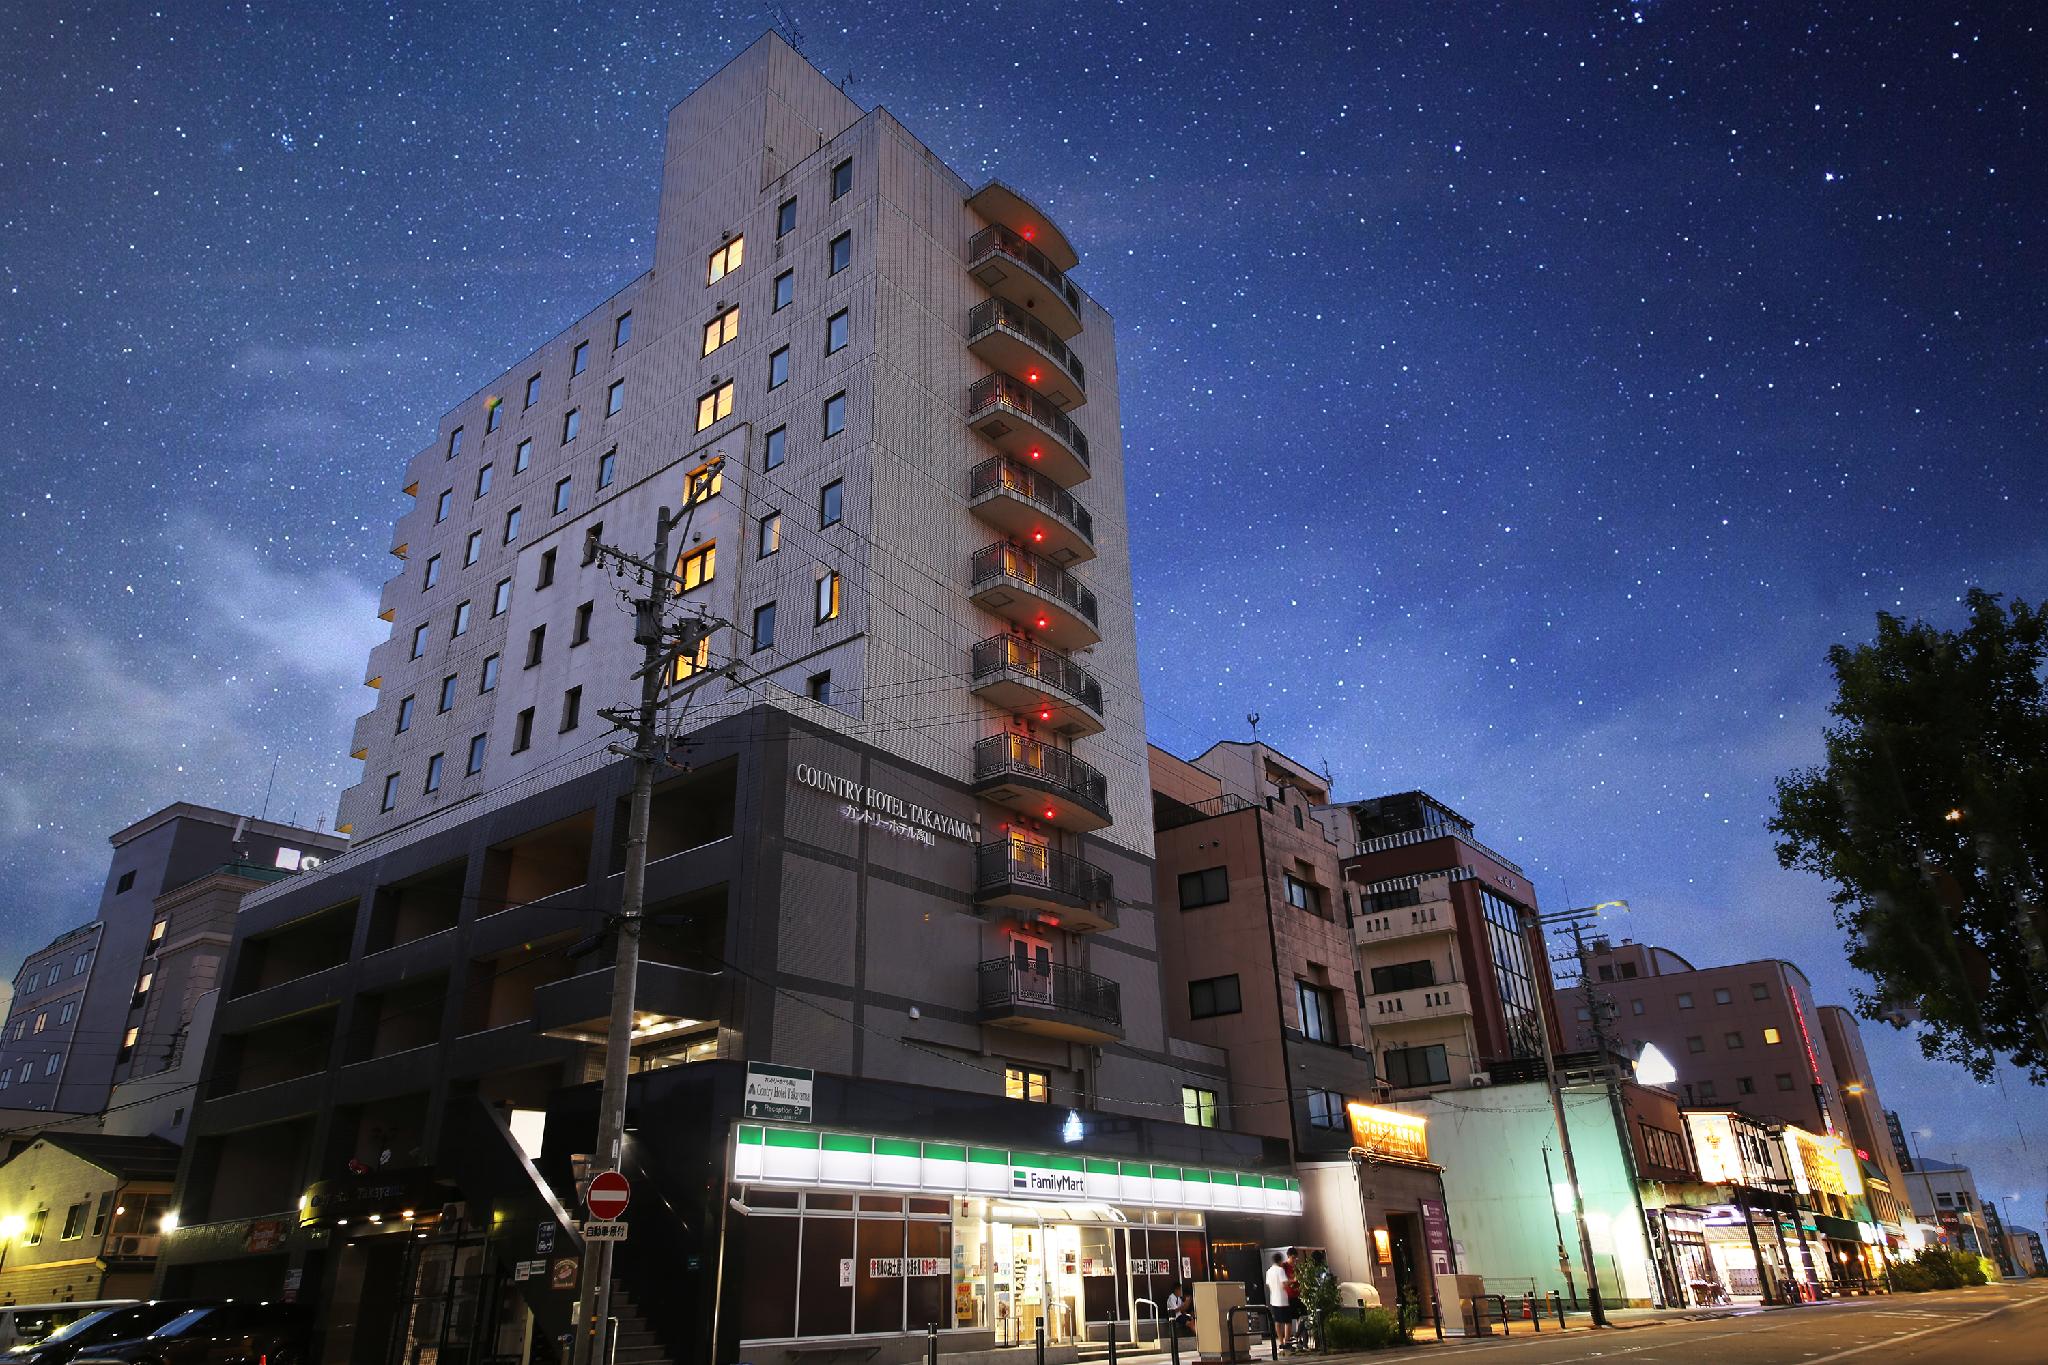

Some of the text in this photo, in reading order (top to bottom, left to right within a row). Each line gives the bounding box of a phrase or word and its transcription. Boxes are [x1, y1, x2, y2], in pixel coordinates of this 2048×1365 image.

[797, 764, 974, 843] COUNTRY HOTEL TAKAYAMA
[845, 804, 935, 846] カントリーホテル高山
[764, 1103, 792, 1115] Reception
[1031, 1172, 1084, 1192] FamilyMart
